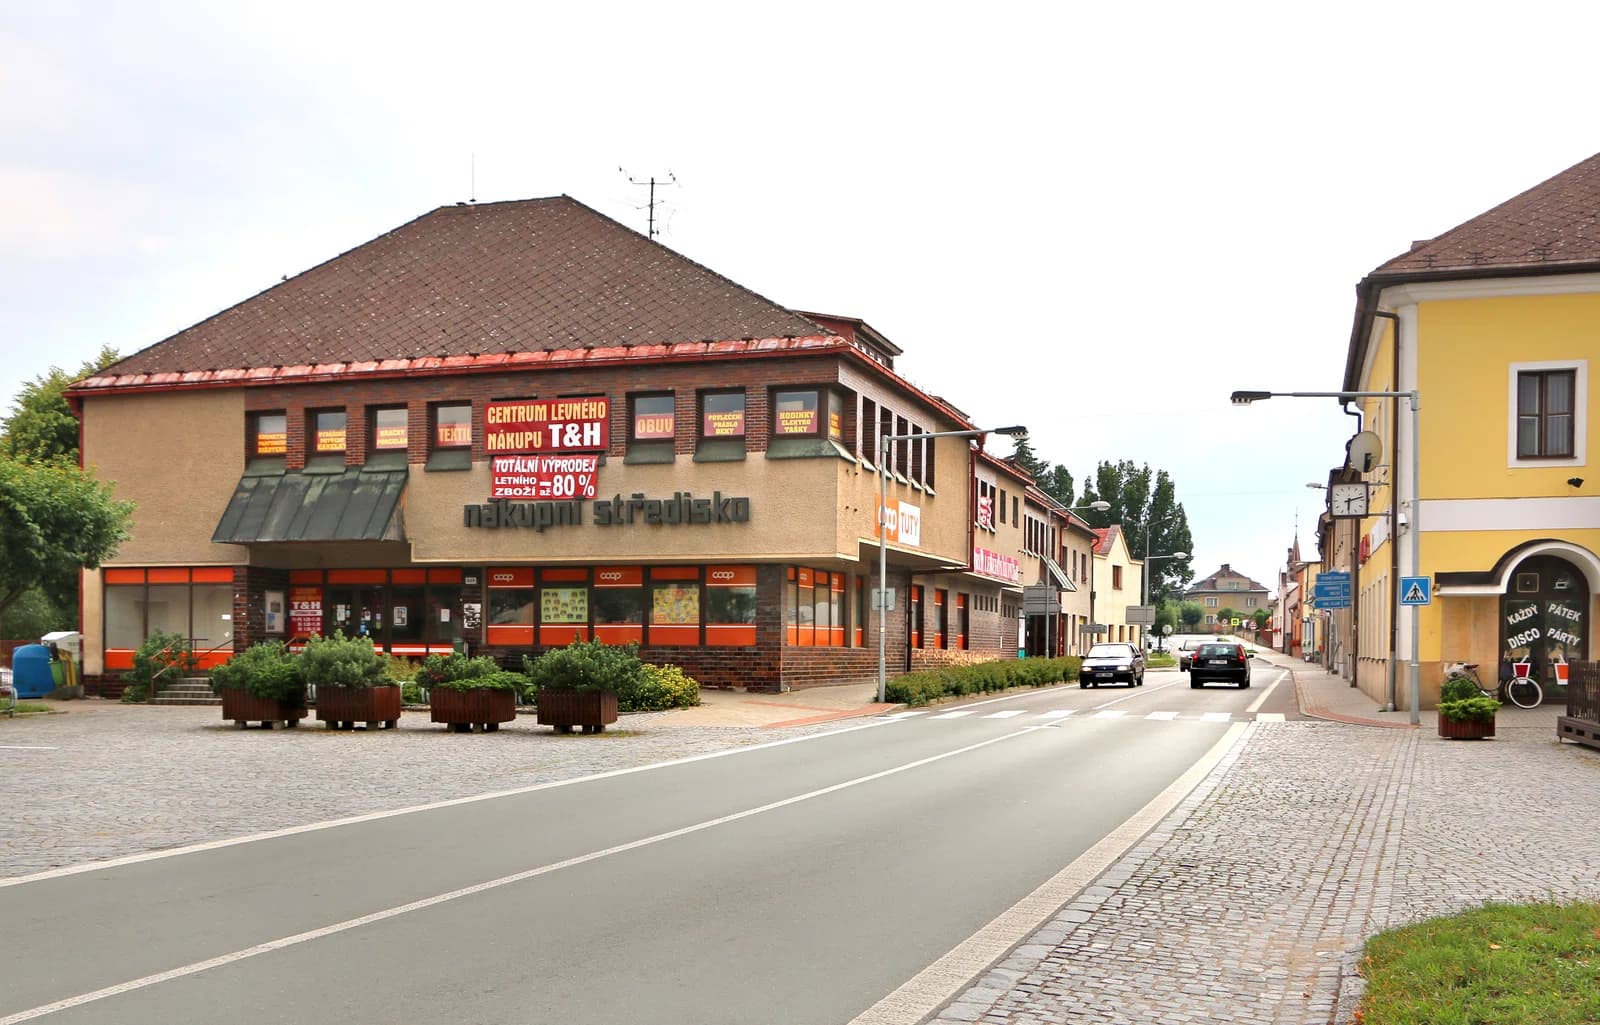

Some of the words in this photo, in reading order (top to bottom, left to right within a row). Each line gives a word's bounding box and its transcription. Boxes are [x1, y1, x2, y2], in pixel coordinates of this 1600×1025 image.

[487, 404, 547, 424] CENTRUM
[551, 399, 606, 421] LEVNÉHO
[637, 418, 673, 434] OBUV
[438, 427, 472, 442] TEXTIL
[487, 430, 542, 450] NÁKUPU
[548, 422, 601, 448] T&H
[495, 456, 539, 473] TOTÁLNÍ
[541, 456, 596, 473] VÝPRODEJ
[495, 475, 537, 485] LETNÍHO
[495, 486, 536, 496] ZBOŽÍ
[540, 488, 551, 496] až
[463, 496, 585, 532] nákupní
[593, 491, 750, 525] středisko
[901, 511, 919, 537] TUTY
[493, 573, 514, 582] coop
[600, 571, 621, 581] coop
[712, 570, 735, 580] coop
[292, 601, 321, 610] T&H
[1507, 603, 1538, 625] KAŽDÝ
[1548, 603, 1581, 621] PÁTEK
[1507, 628, 1540, 649] DISCO
[1547, 627, 1580, 646] PÁRTY
